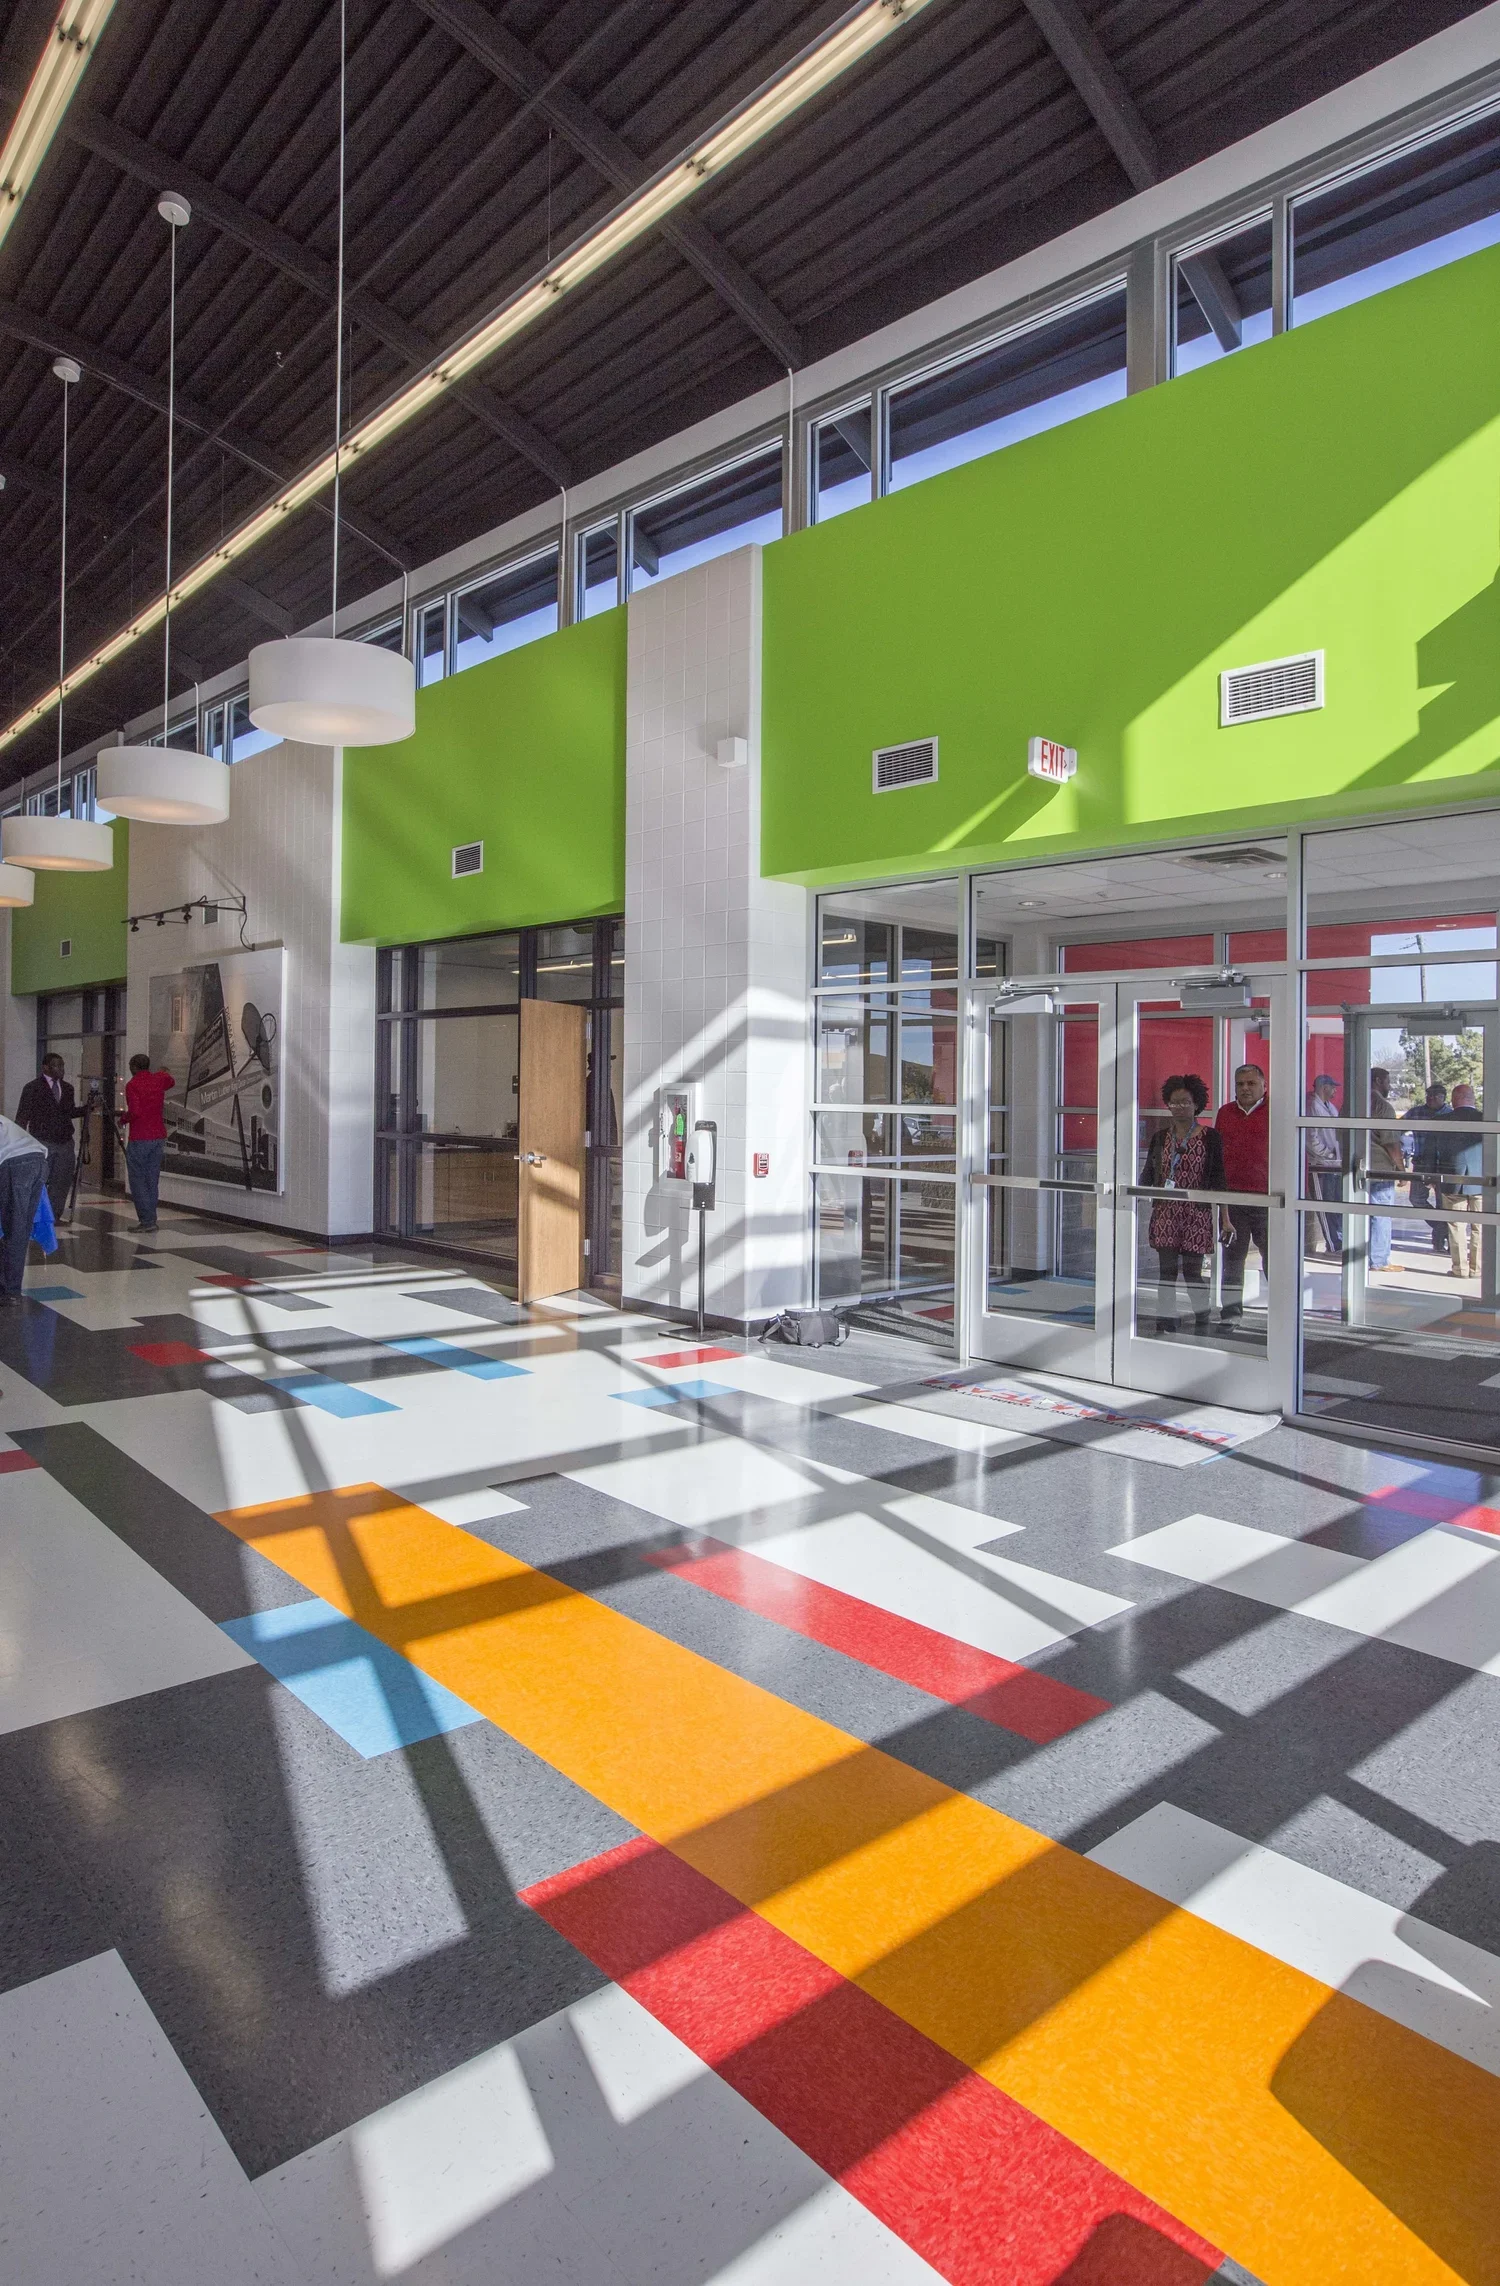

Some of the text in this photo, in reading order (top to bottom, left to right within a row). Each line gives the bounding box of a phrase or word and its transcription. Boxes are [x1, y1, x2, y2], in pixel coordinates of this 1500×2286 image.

[1041, 740, 1065, 778] EXIT
[201, 1090, 218, 1106] Martin
[961, 1391, 1030, 1407] COMMUNITY
[922, 1376, 1238, 1444] DREAM TEAM
[1049, 1409, 1081, 1418] KING
[1082, 1416, 1133, 1429] LUTHER
[1135, 1427, 1190, 1441] MARTIN
